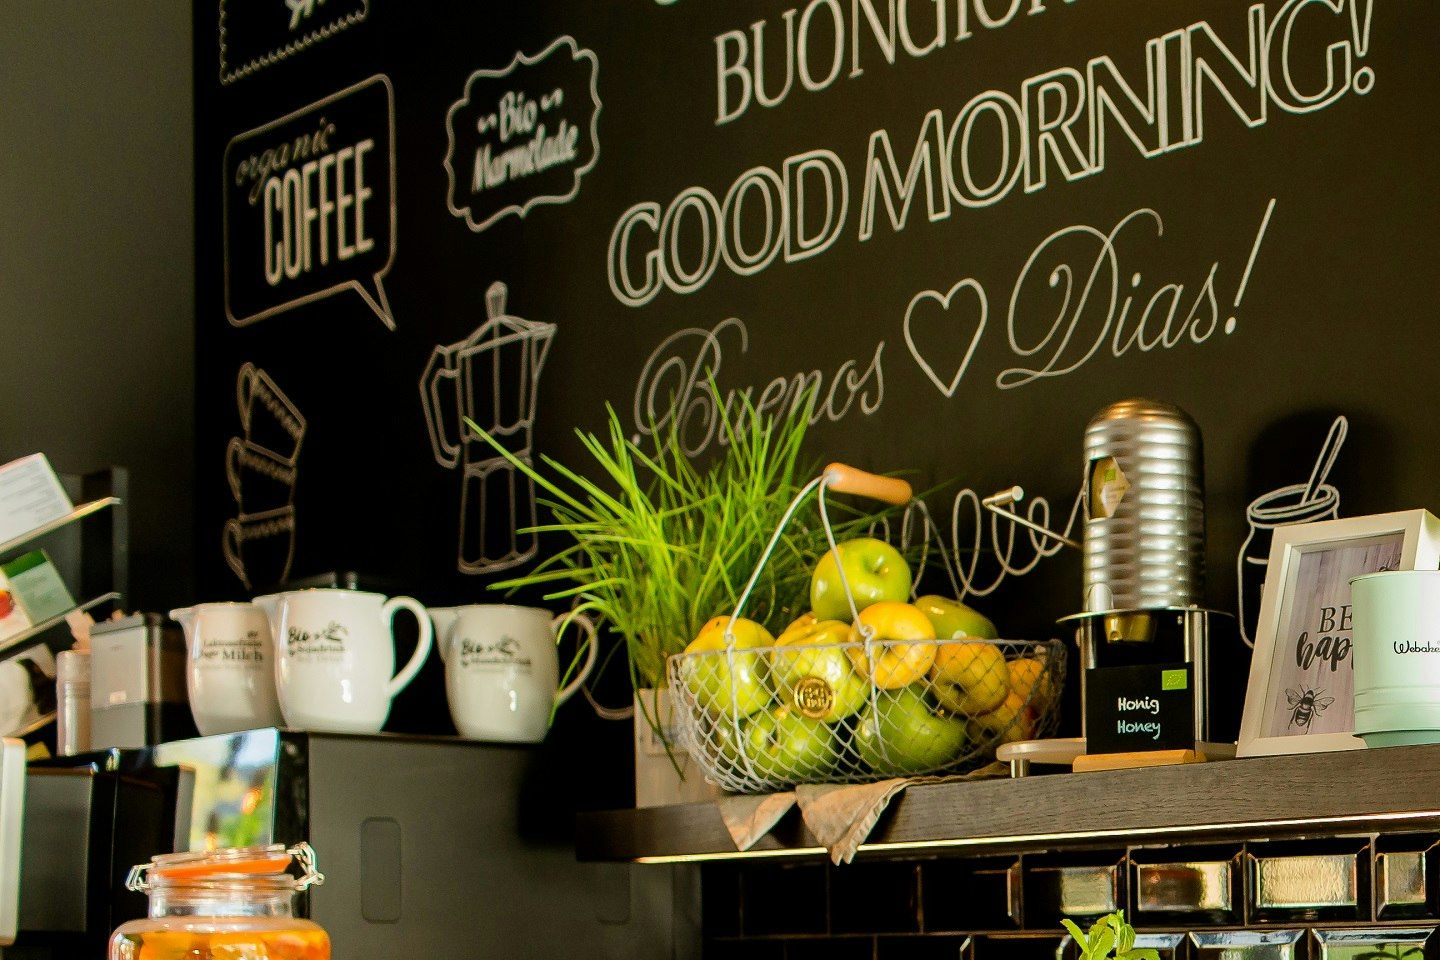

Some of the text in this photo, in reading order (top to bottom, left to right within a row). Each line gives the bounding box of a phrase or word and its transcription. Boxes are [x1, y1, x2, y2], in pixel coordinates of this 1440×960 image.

[498, 90, 539, 144] Bio
[235, 117, 337, 206] organic
[607, 0, 1376, 308] GOOD MORNING!
[262, 138, 375, 286] COFFEE
[631, 198, 1277, 468] Buenos Dias!
[1317, 604, 1353, 634] BE
[1296, 631, 1354, 673] hap
[1393, 640, 1440, 655] Webake
[1117, 696, 1160, 715] Honig
[1117, 718, 1161, 741] Honey
